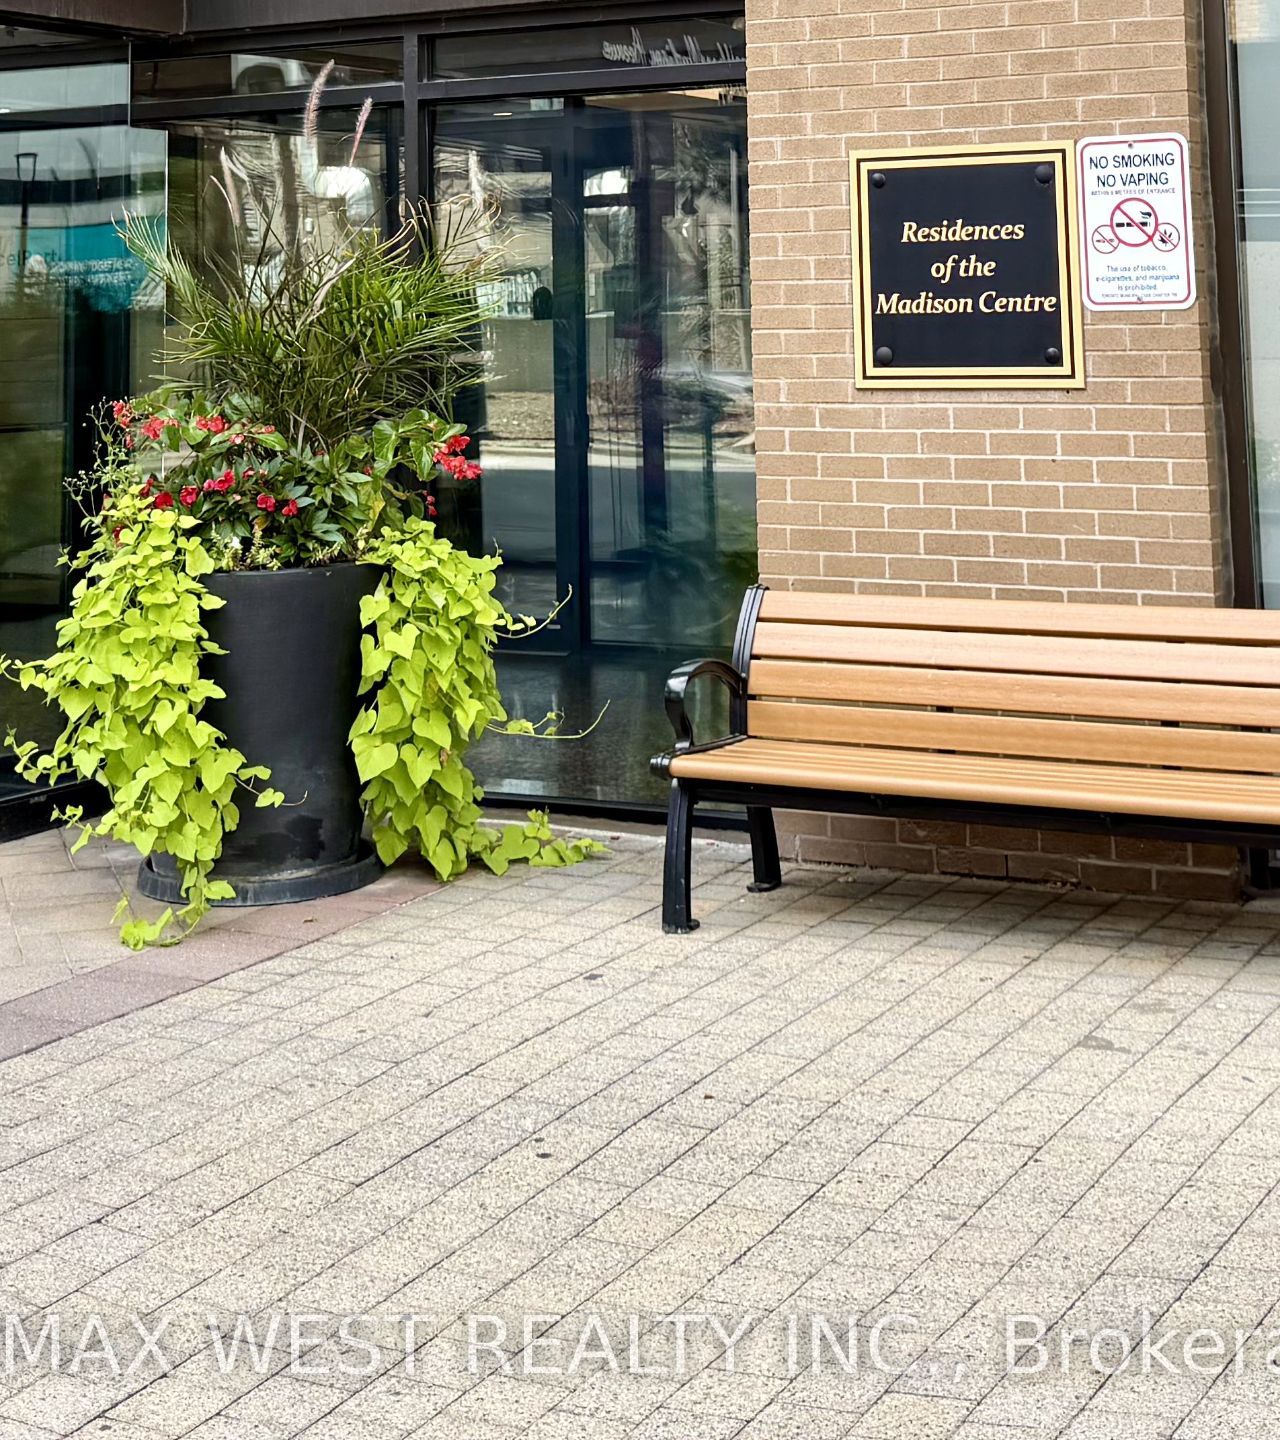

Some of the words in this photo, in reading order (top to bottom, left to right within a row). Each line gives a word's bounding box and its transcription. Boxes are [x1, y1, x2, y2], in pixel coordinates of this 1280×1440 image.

[1089, 155, 1109, 170] NO
[1112, 152, 1175, 169] SMOKING
[1096, 174, 1117, 188] NO
[1120, 171, 1169, 187] VAPING
[901, 218, 1025, 243] Residences
[930, 254, 959, 284] of
[958, 254, 997, 277] the
[1133, 264, 1140, 272] of
[1135, 274, 1148, 282] and
[1149, 274, 1180, 282] marijuana
[874, 291, 974, 315] Madison
[978, 290, 1058, 313] Centre
